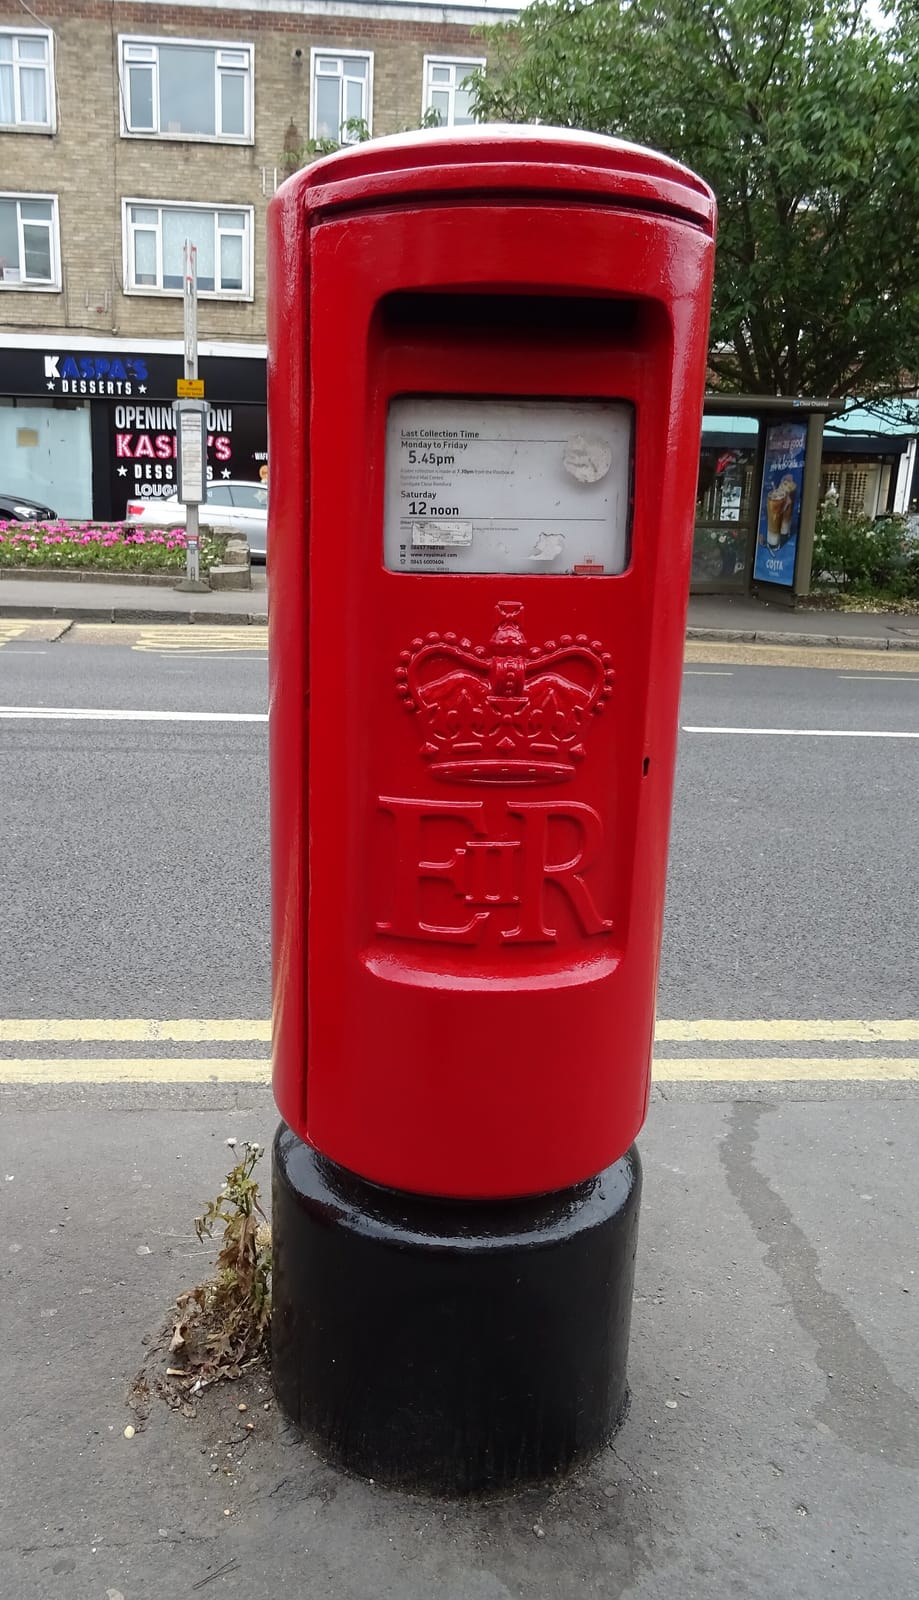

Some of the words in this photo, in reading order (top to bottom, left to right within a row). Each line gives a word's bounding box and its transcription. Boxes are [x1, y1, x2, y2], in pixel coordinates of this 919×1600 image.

[44, 355, 149, 380] KASPA'S
[61, 380, 132, 395] DESSERTS
[401, 429, 418, 438] Last
[420, 429, 458, 438] Collection
[460, 430, 480, 439] Time
[115, 433, 232, 461] KAS'S
[401, 441, 432, 450] Monday
[433, 441, 442, 449] to
[443, 441, 468, 450] Friday
[408, 450, 455, 467] 5.45pm
[401, 490, 437, 500] Saturday
[408, 501, 427, 515] 12
[430, 507, 459, 516] noon
[766, 559, 783, 571] COSTA
